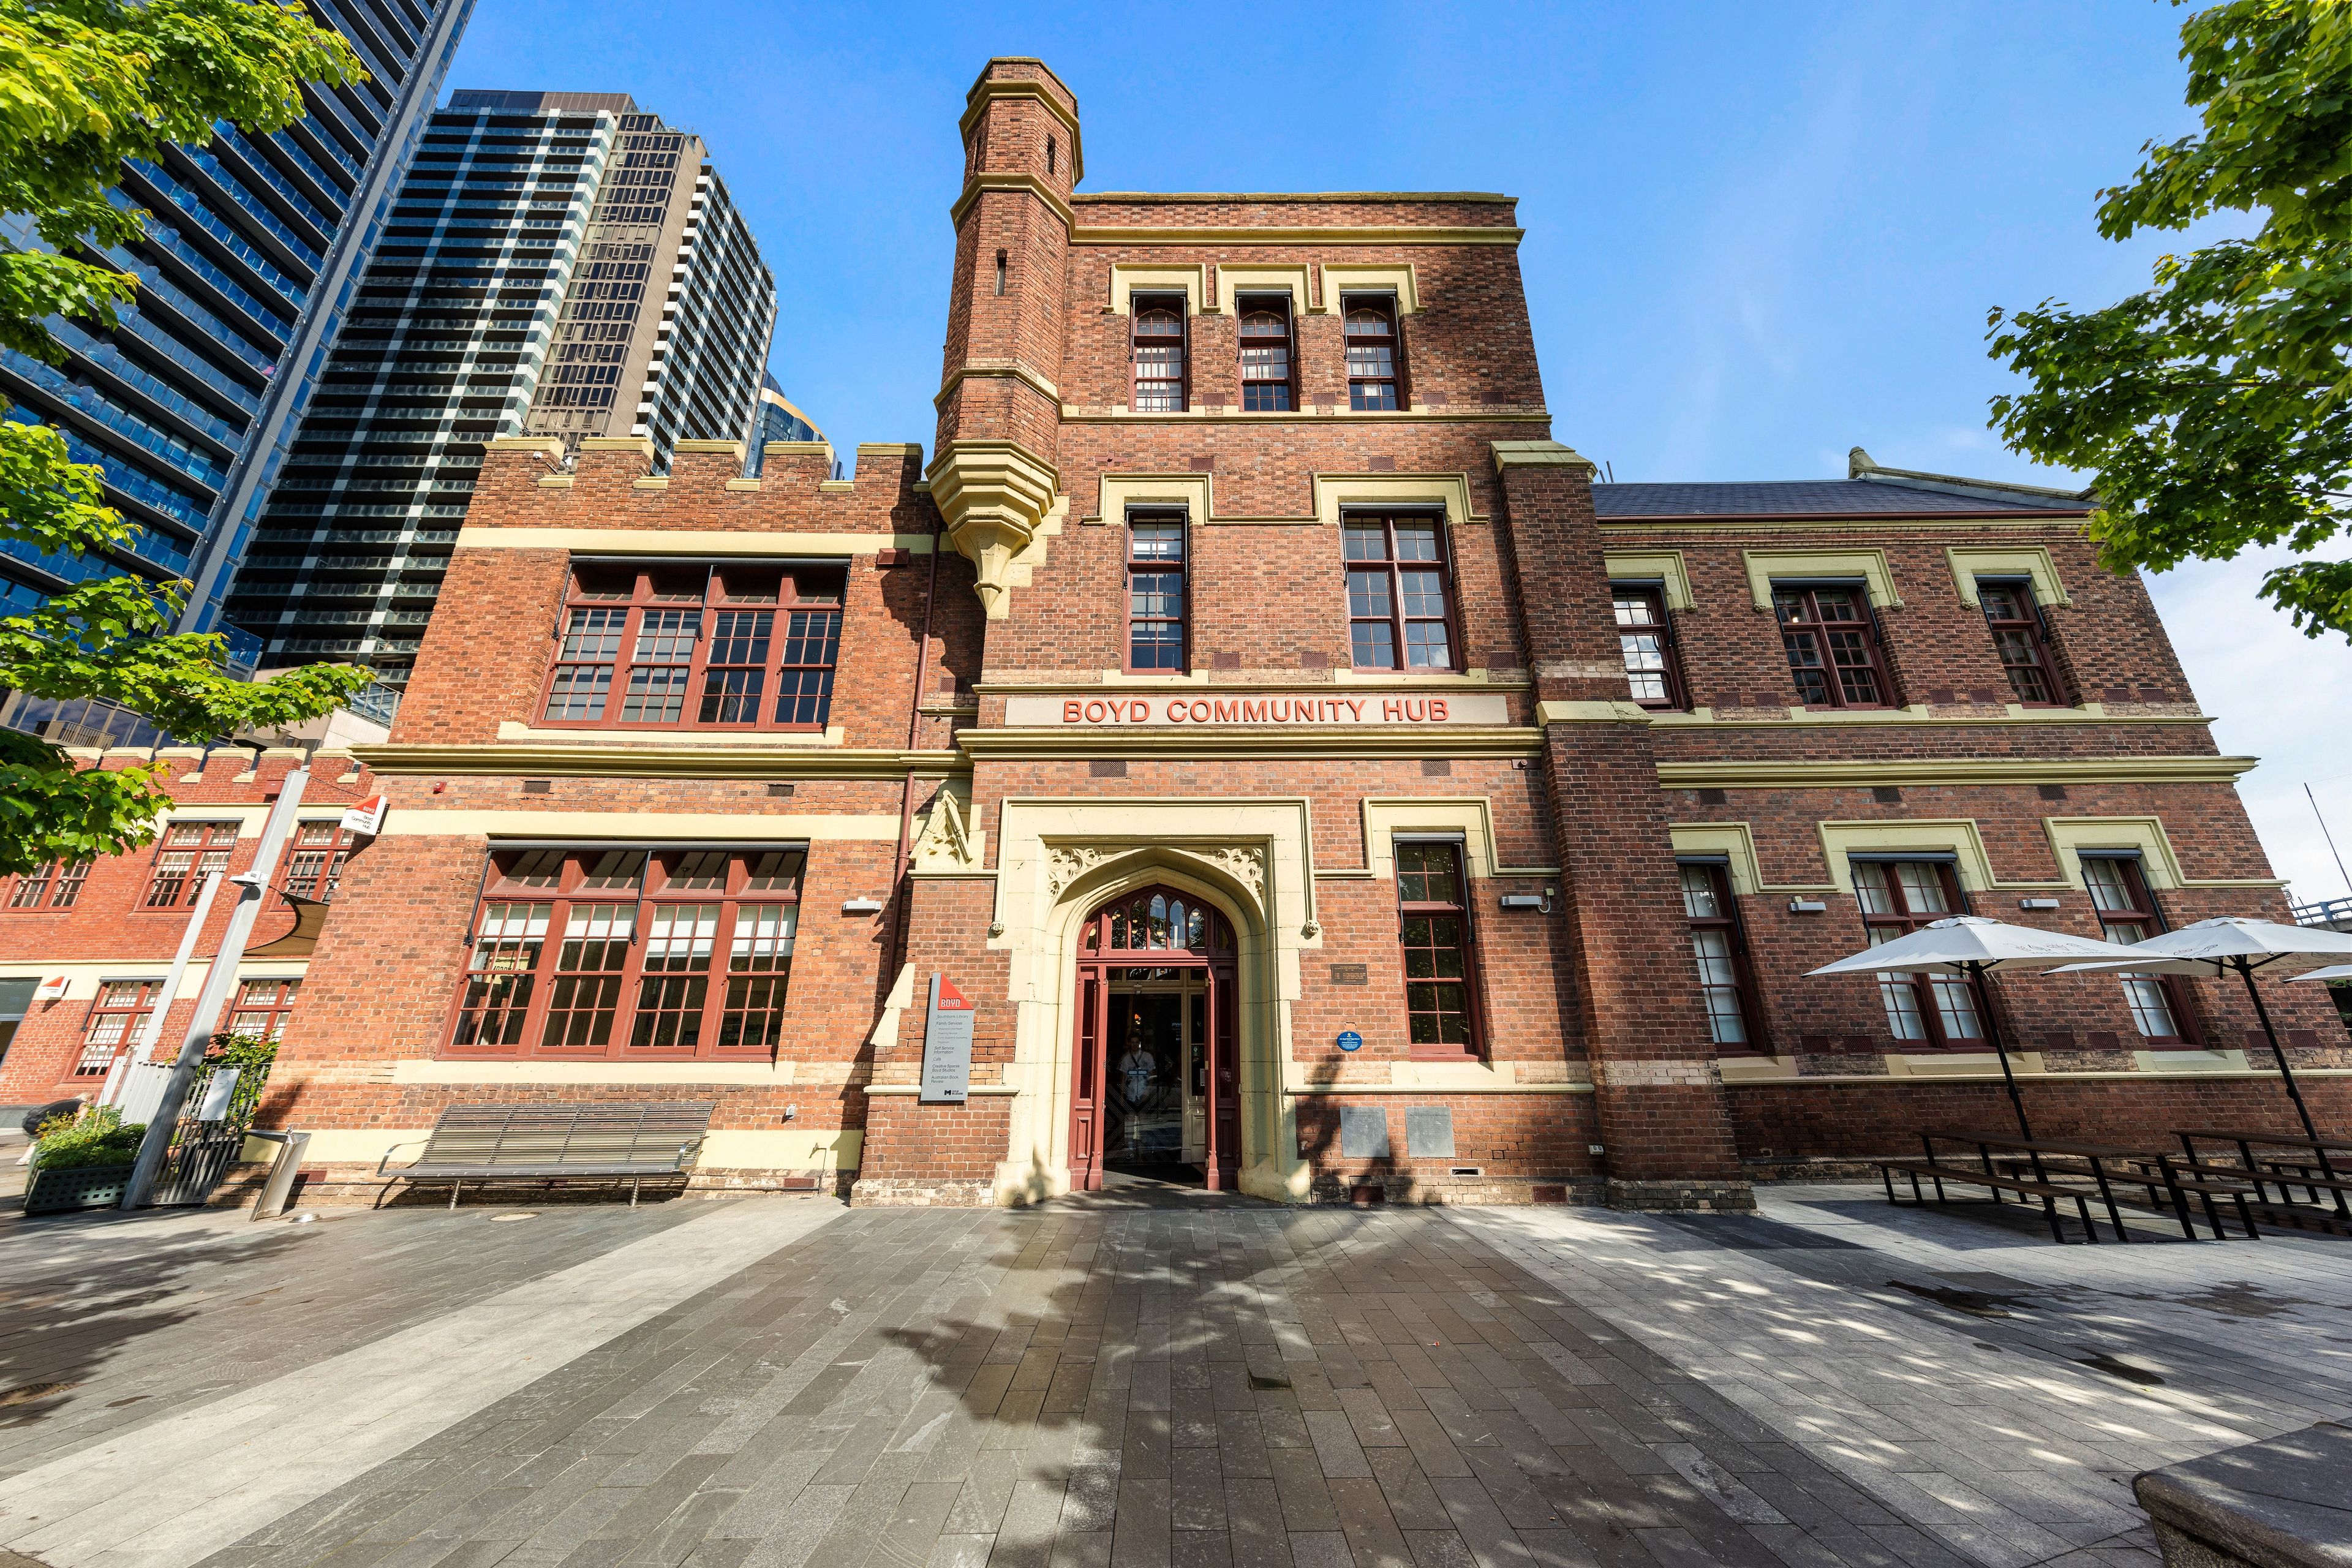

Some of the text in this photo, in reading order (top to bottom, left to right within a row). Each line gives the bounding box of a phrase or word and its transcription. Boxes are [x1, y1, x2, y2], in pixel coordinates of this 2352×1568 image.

[1063, 699, 1450, 723] BOYD COMMUNITY HUB
[351, 816, 371, 825] Community
[941, 998, 961, 1007] BOYD
